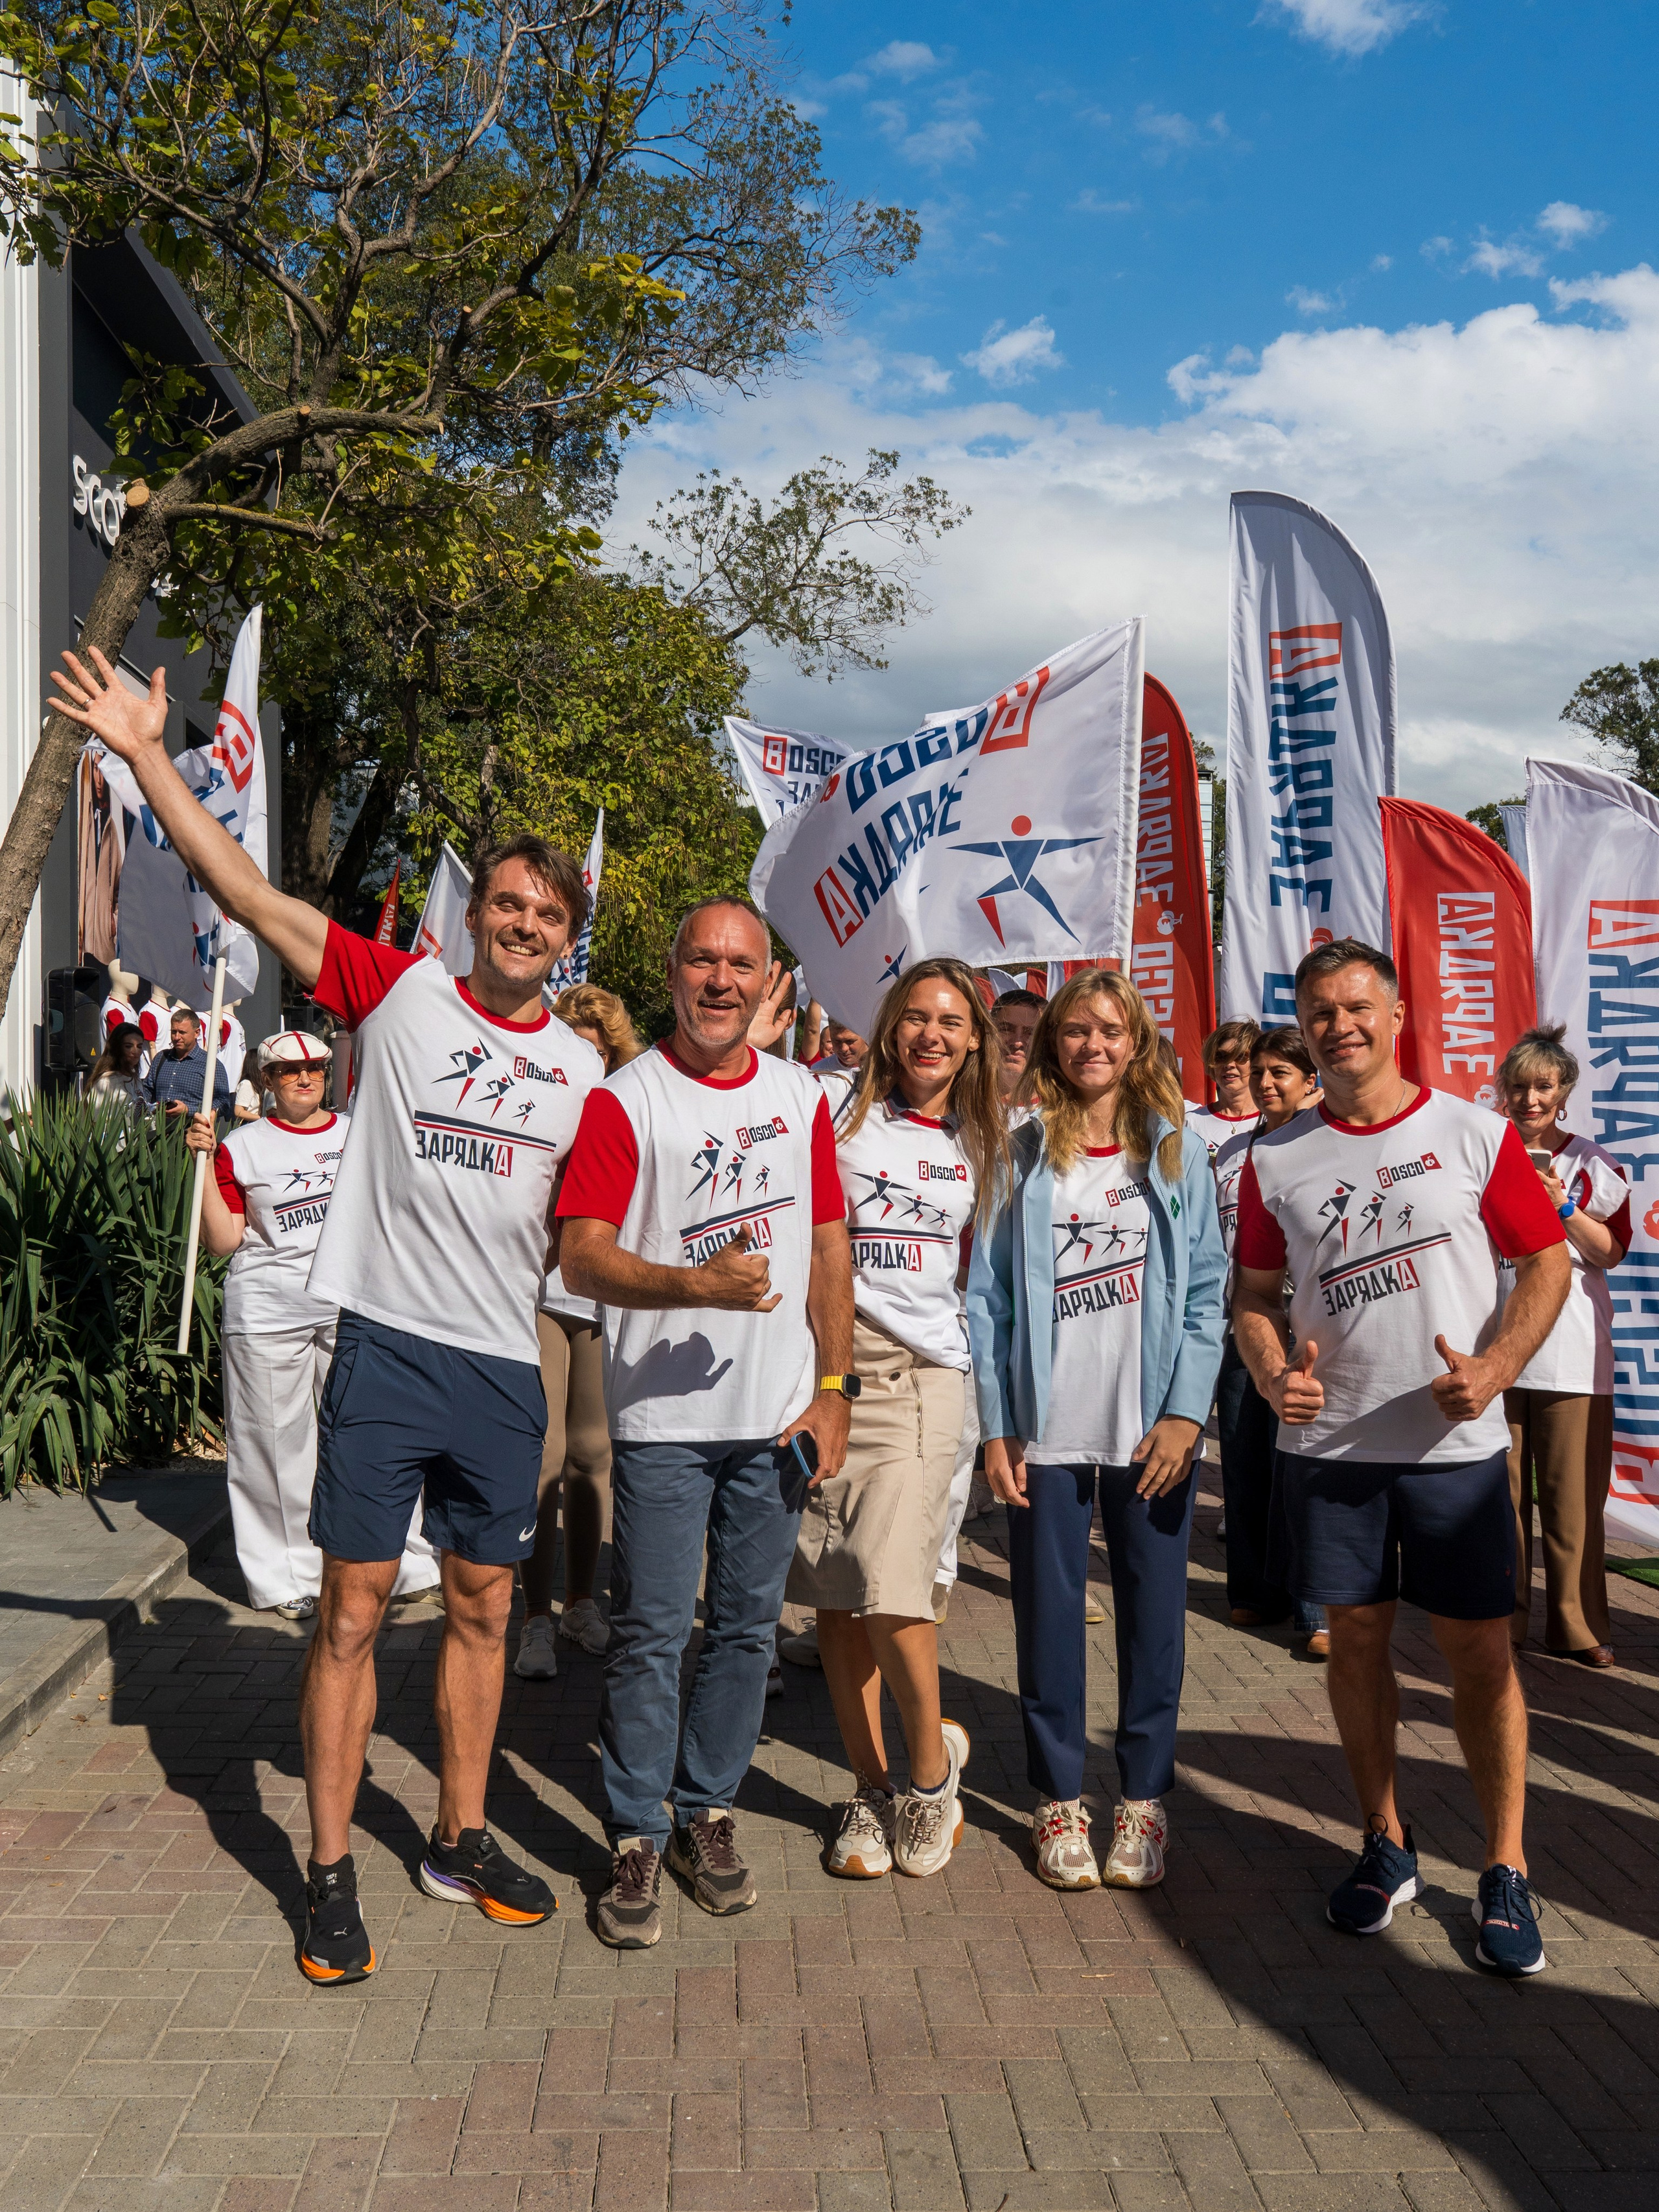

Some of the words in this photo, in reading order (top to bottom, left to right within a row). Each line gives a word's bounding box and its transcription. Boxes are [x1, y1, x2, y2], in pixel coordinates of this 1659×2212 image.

[736, 1124, 777, 1150] BOSCO
[314, 1152, 342, 1164] BOSCO
[415, 1130, 513, 1178] ЗАРЯДКА
[918, 1161, 956, 1181] BOSCO
[1376, 1161, 1425, 1189] BOSCO
[1105, 1182, 1148, 1207] BOSCO
[276, 1202, 327, 1233] ЗАРЯДК
[851, 1242, 922, 1272] АРЯДКА
[1322, 1258, 1421, 1316] ЗАРЯДКА
